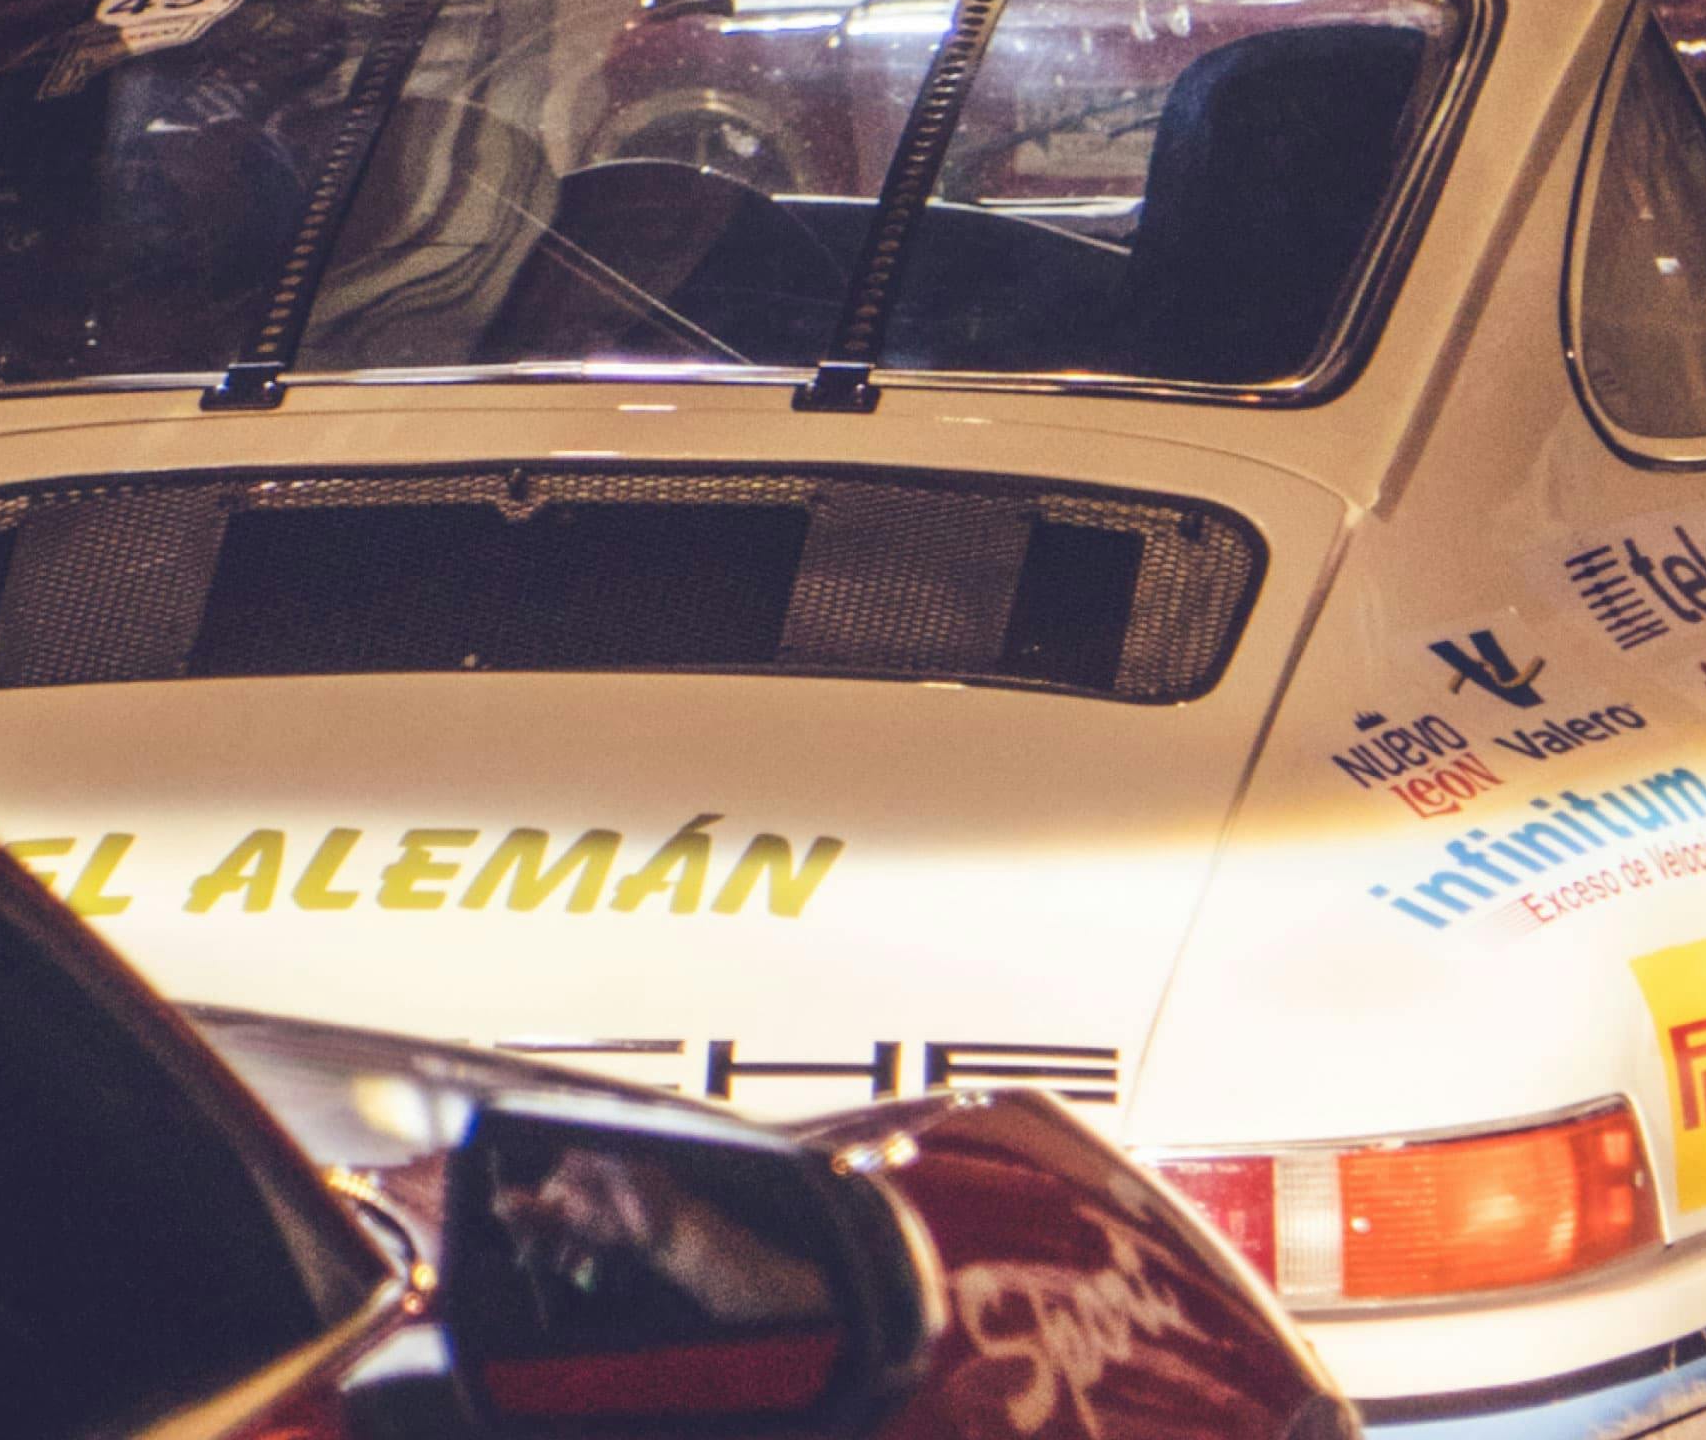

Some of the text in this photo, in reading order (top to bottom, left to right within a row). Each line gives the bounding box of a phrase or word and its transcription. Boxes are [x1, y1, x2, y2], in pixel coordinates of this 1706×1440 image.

[1493, 704, 1647, 760] Valero
[182, 812, 846, 918] ALEMÁN
[1521, 866, 1622, 924] Exceso
[1619, 855, 1654, 889] de
